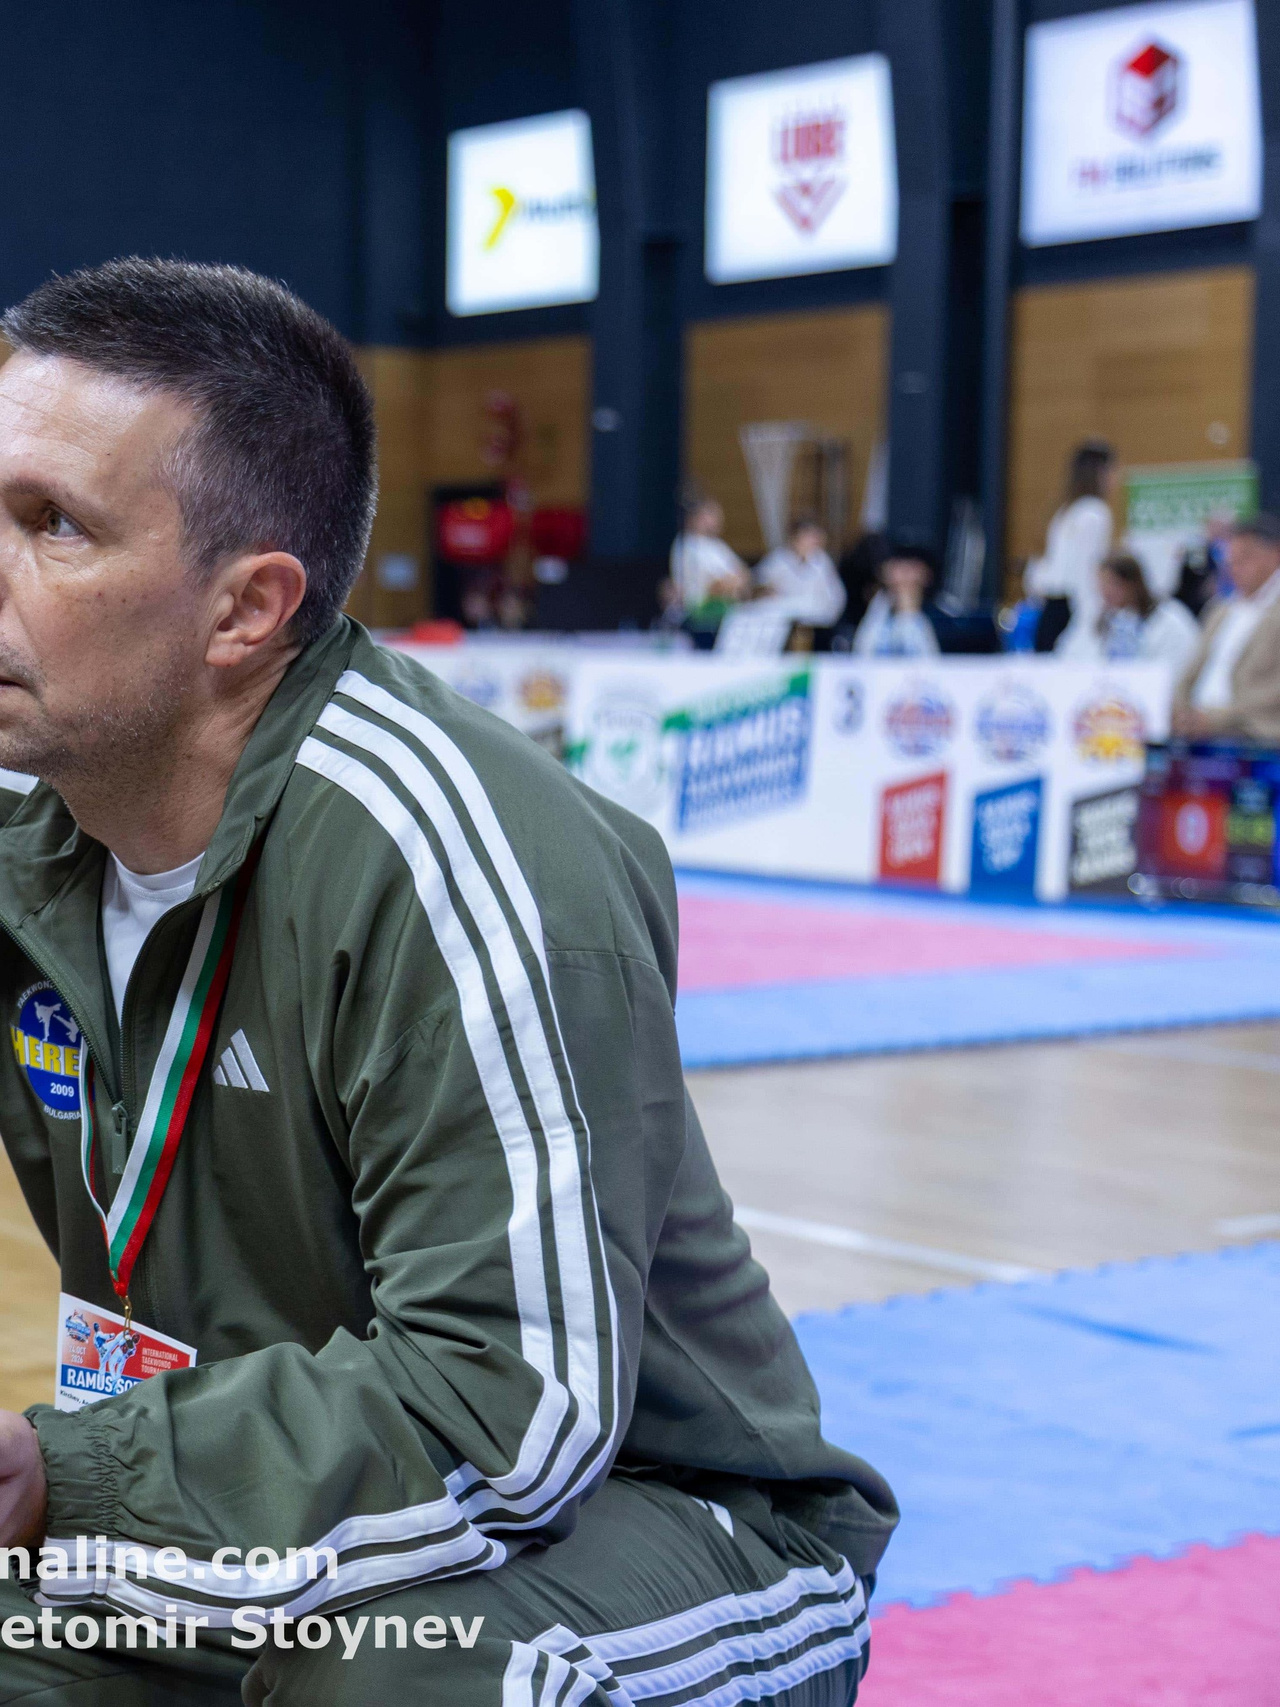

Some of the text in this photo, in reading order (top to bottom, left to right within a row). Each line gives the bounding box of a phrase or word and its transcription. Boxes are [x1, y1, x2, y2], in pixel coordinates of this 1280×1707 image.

[50, 1082, 75, 1097] 2009
[43, 1104, 82, 1120] BULGARIA
[66, 1368, 113, 1393] RAMUS
